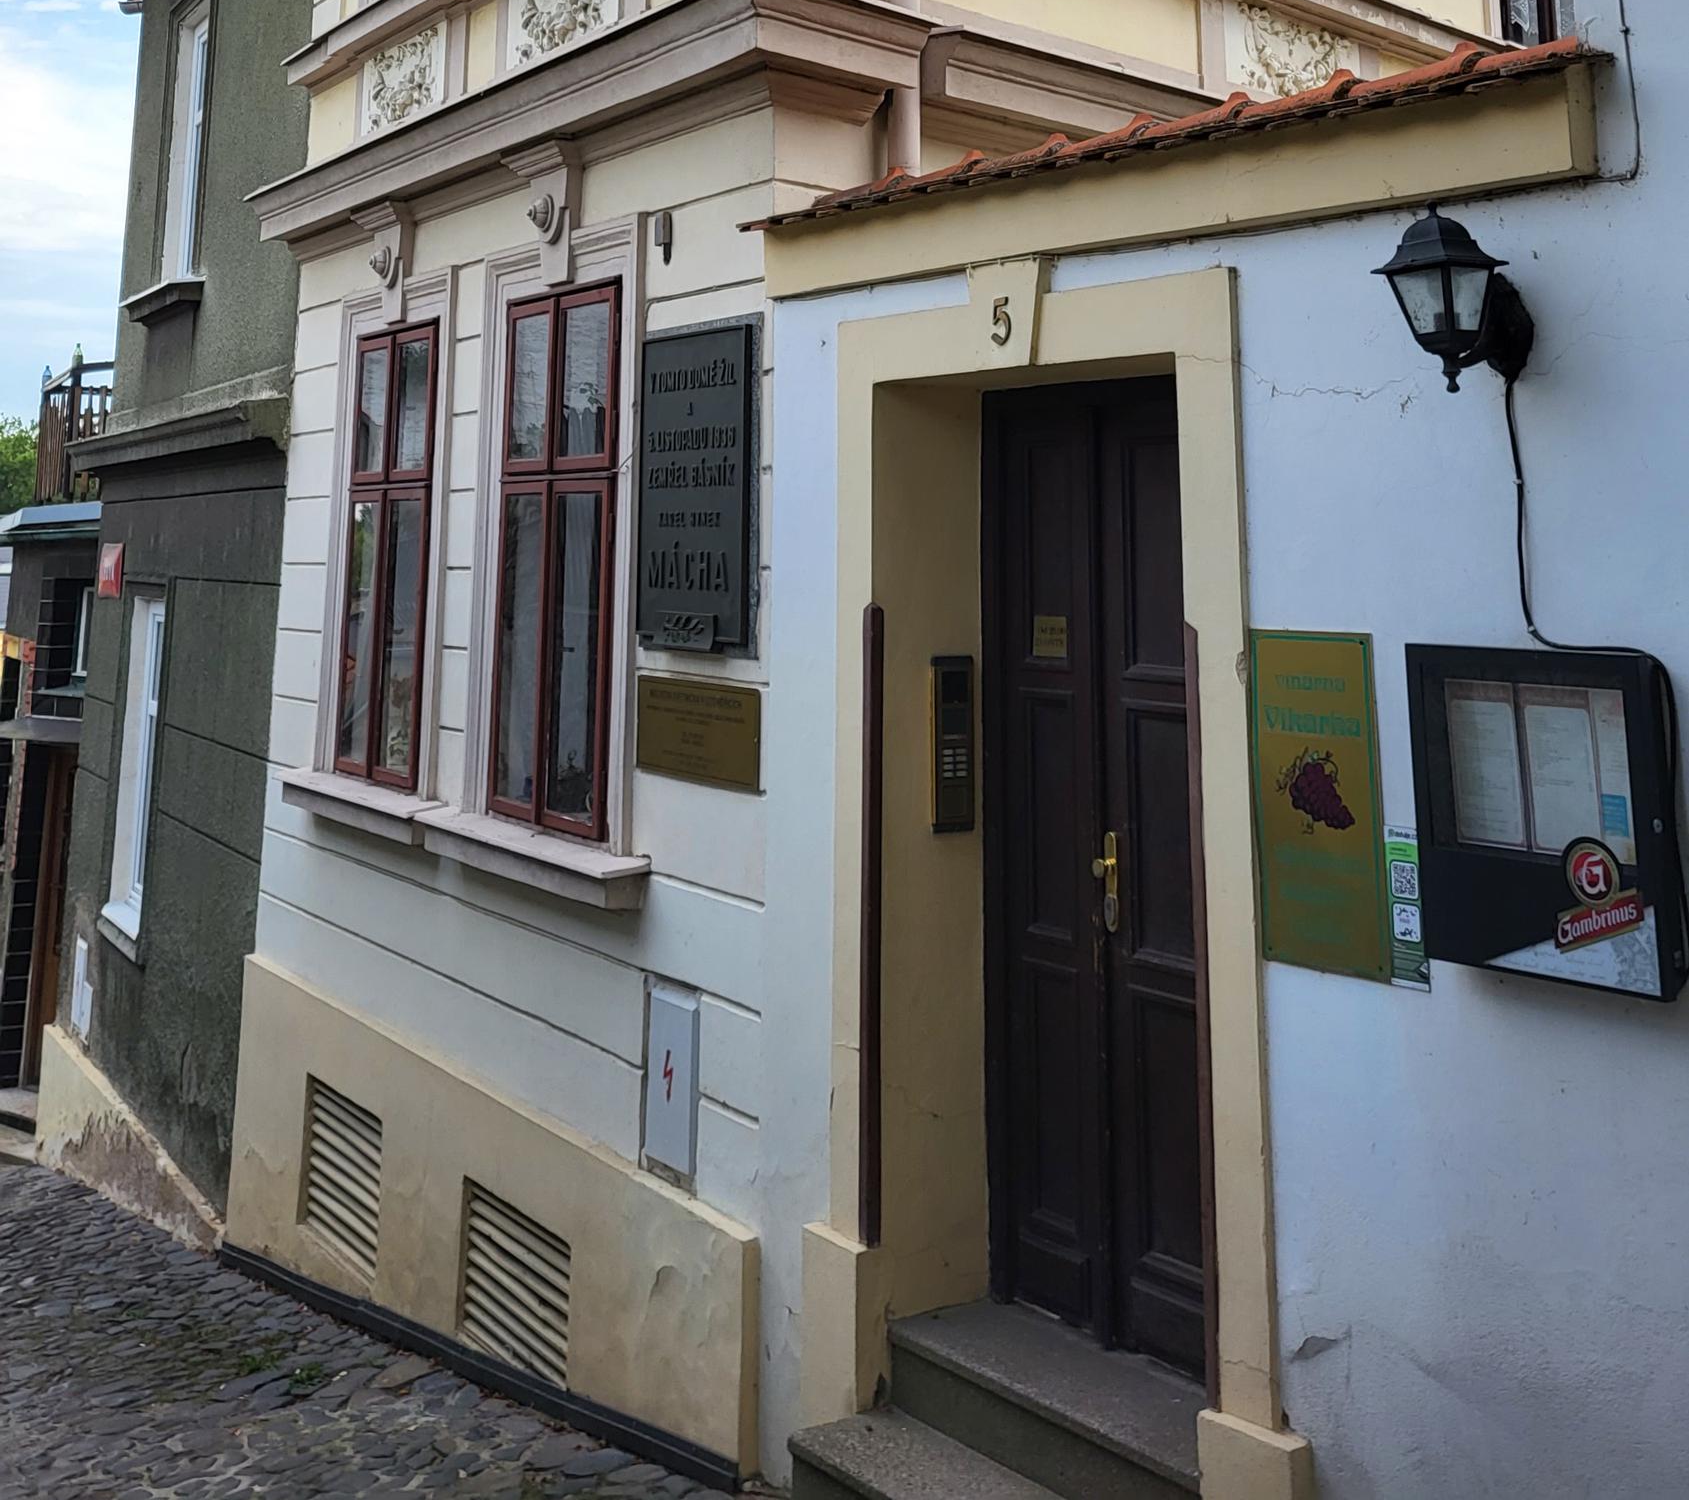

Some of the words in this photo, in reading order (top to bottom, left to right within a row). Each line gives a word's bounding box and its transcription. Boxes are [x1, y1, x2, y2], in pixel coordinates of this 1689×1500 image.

[991, 296, 1012, 346] 5
[649, 372, 657, 395] V
[657, 369, 687, 393] TOMTO
[718, 357, 737, 387] ŽIL
[657, 426, 709, 452] LISTOPADU
[710, 424, 736, 449] 1836
[648, 460, 688, 489] ZEMŘEL
[691, 455, 736, 488] BÁSNÍK
[648, 539, 729, 593] MÁCHA
[1557, 902, 1638, 944] Gambrinus
